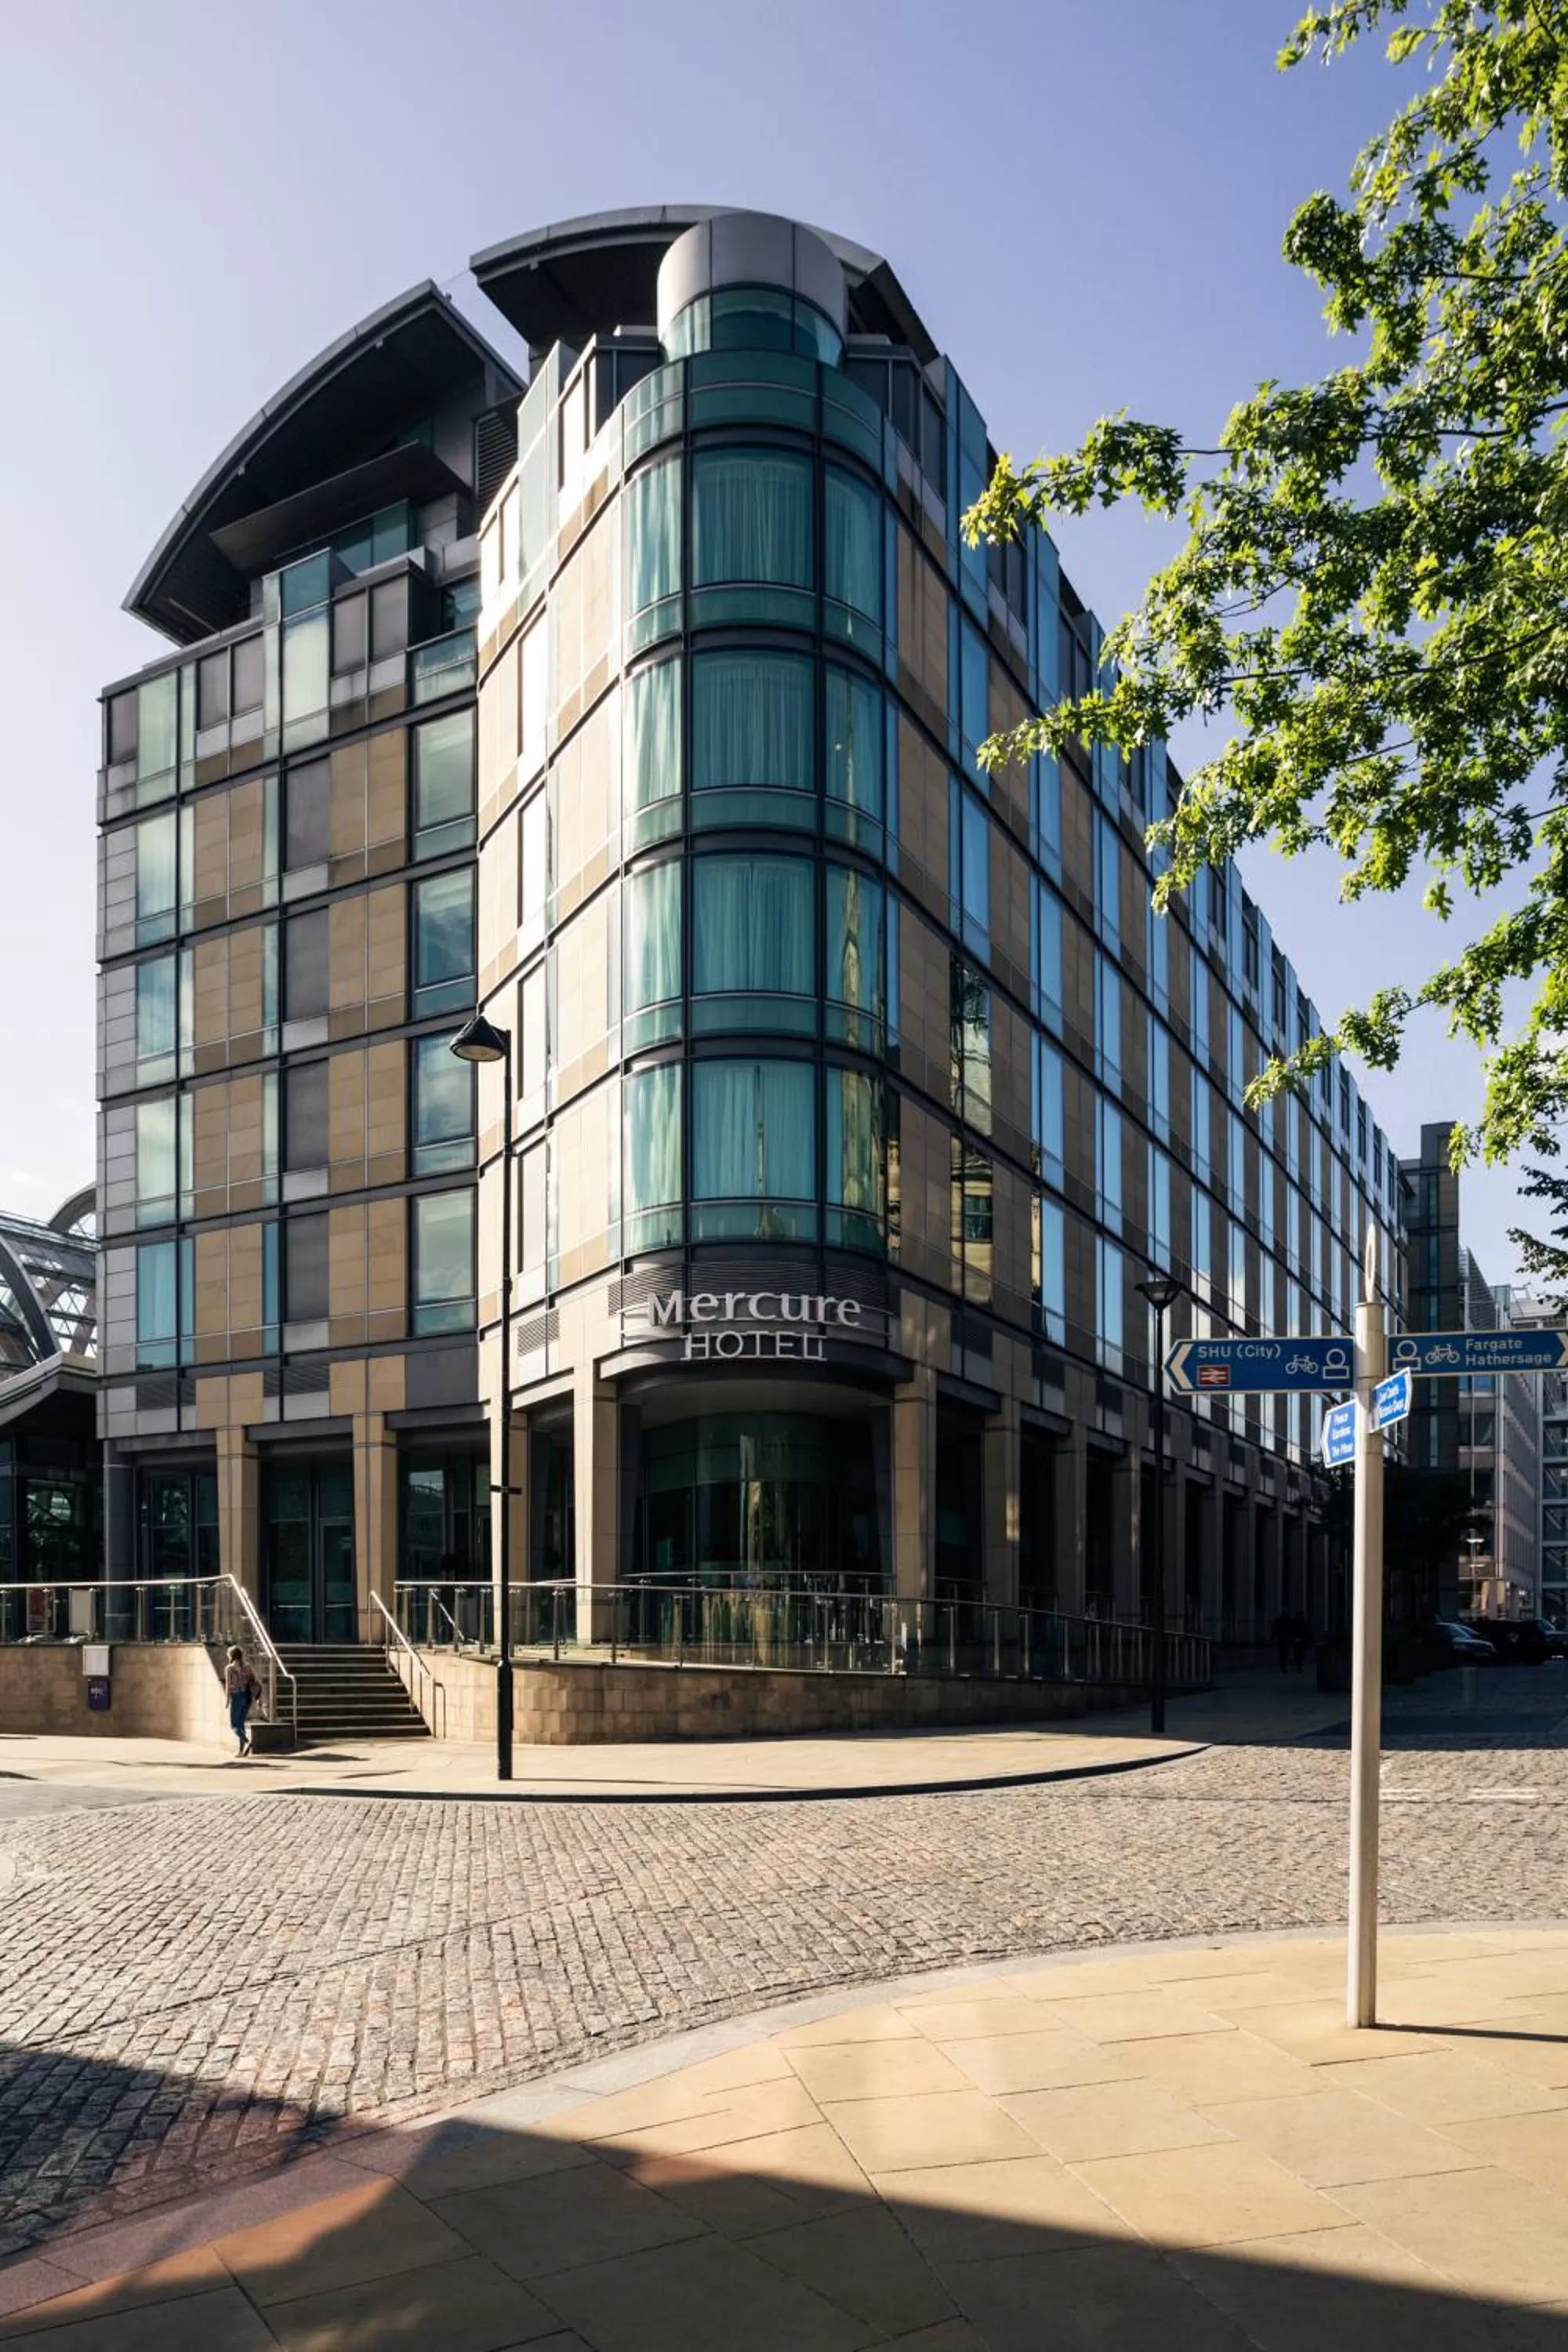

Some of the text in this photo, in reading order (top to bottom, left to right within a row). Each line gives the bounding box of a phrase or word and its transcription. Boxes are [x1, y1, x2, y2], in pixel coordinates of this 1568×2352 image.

[648, 1290, 861, 1327] Mercure
[683, 1331, 826, 1360] HOTEL
[1197, 1343, 1281, 1359] SHU (City)
[1465, 1338, 1523, 1352] Fargate
[1465, 1352, 1552, 1367] Hathersage
